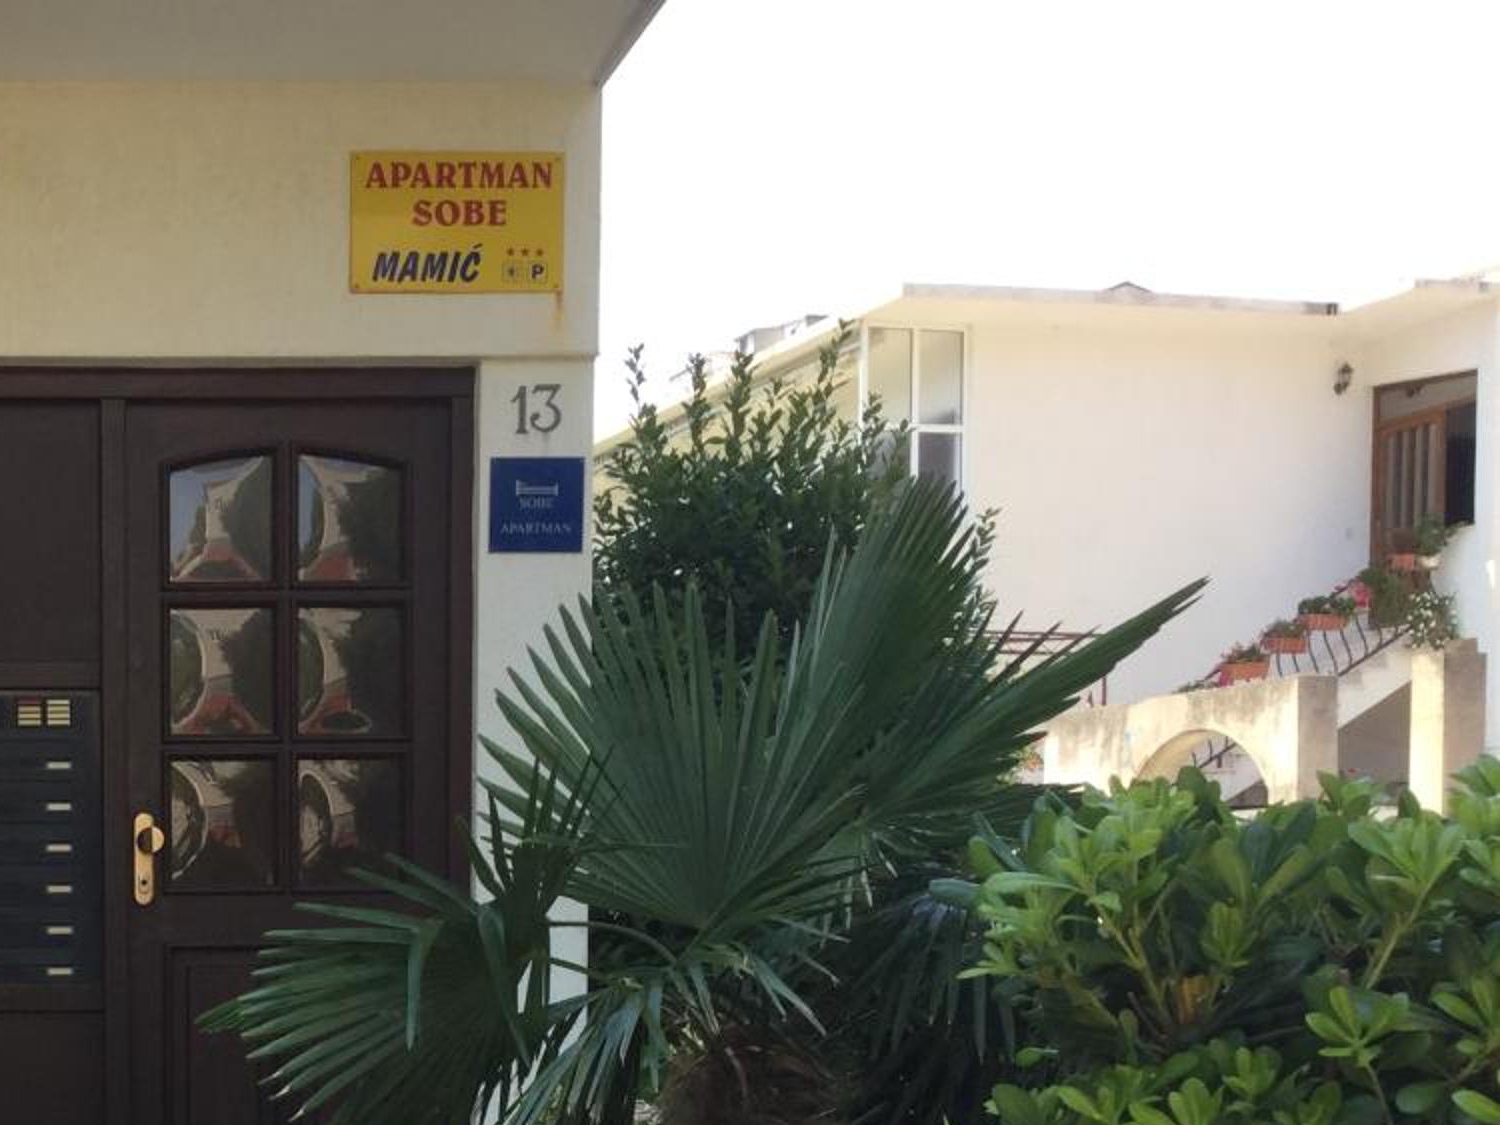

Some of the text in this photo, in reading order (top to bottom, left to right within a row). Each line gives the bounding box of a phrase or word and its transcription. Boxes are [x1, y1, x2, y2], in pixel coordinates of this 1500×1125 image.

[365, 161, 553, 189] APARTMAN
[412, 199, 508, 226] SOBE
[372, 244, 483, 284] MAMIĆ
[531, 264, 544, 280] P
[510, 383, 562, 434] 13
[500, 521, 573, 536] APARTMAN
